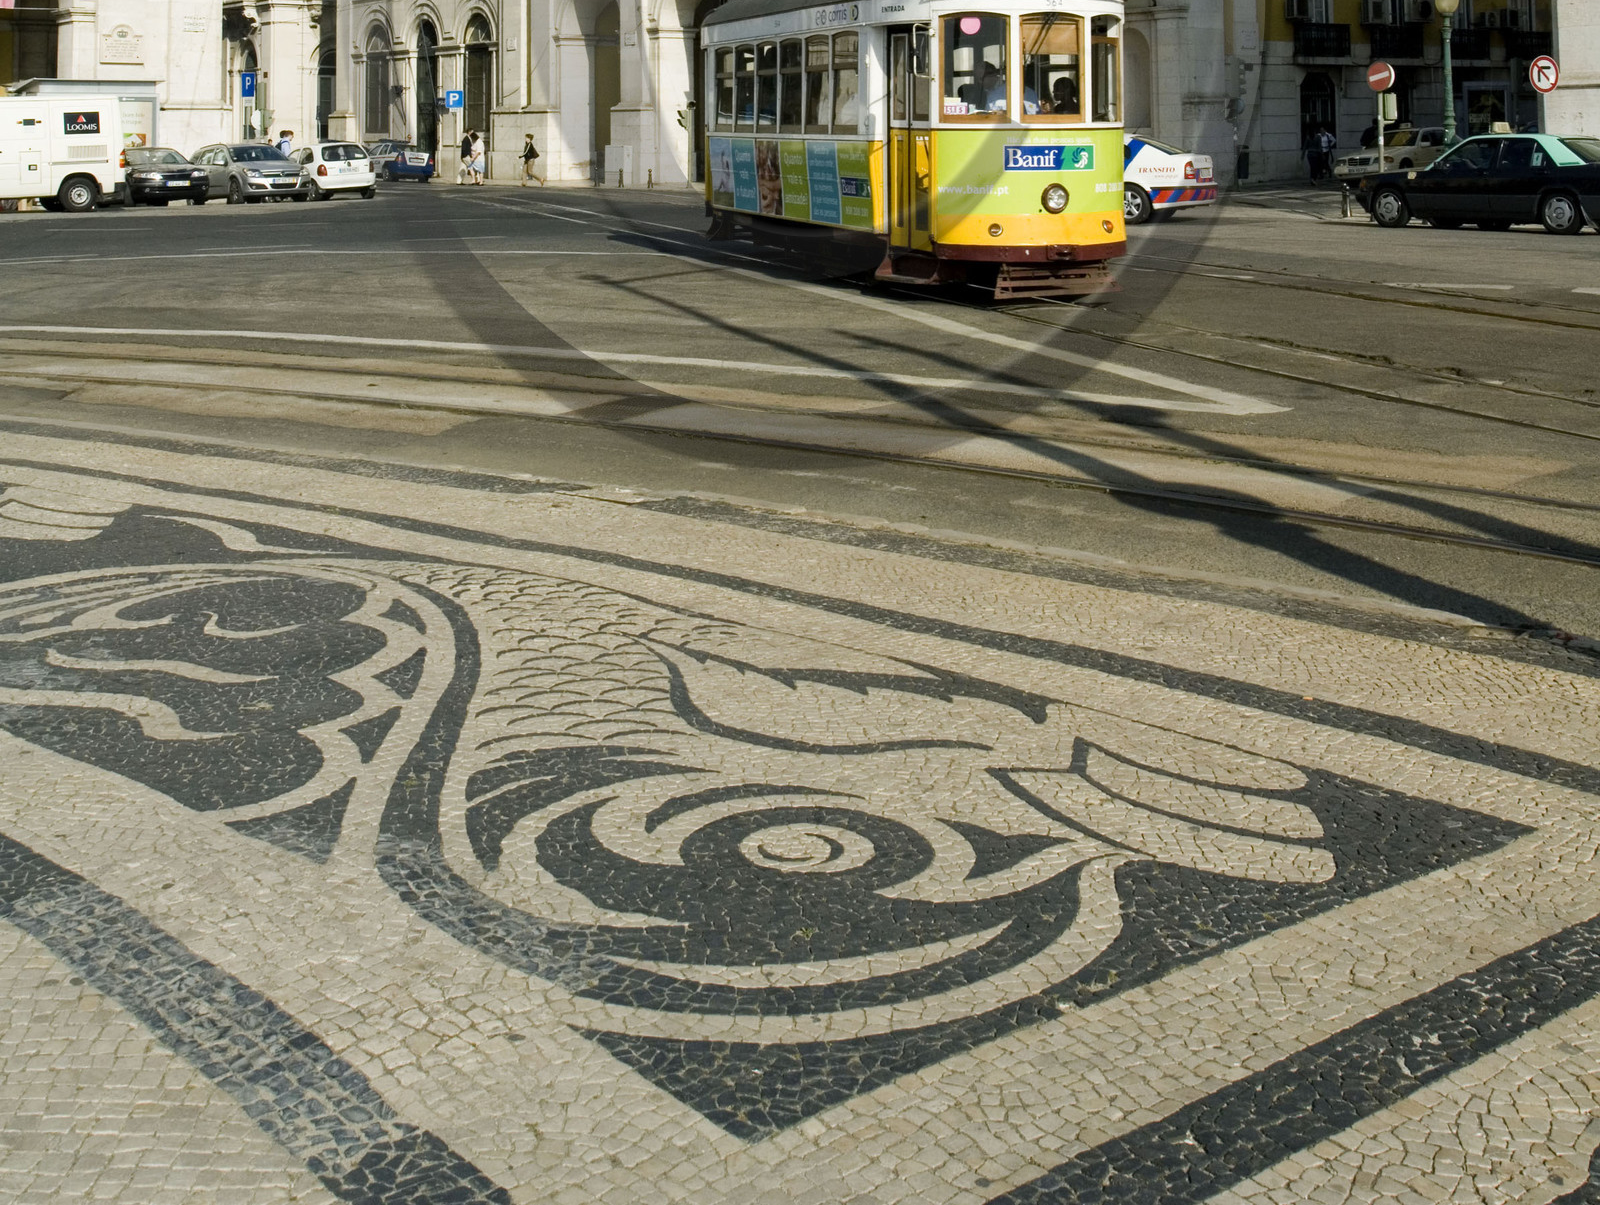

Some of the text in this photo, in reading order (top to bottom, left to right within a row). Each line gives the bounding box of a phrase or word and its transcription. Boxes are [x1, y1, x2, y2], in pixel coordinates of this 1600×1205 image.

[881, 4, 905, 13] ENTRADA
[245, 76, 252, 90] P
[450, 92, 460, 106] P
[66, 123, 98, 131] LOOMIS
[1006, 148, 1058, 168] Banif
[938, 184, 1009, 196] www.banif.pt
